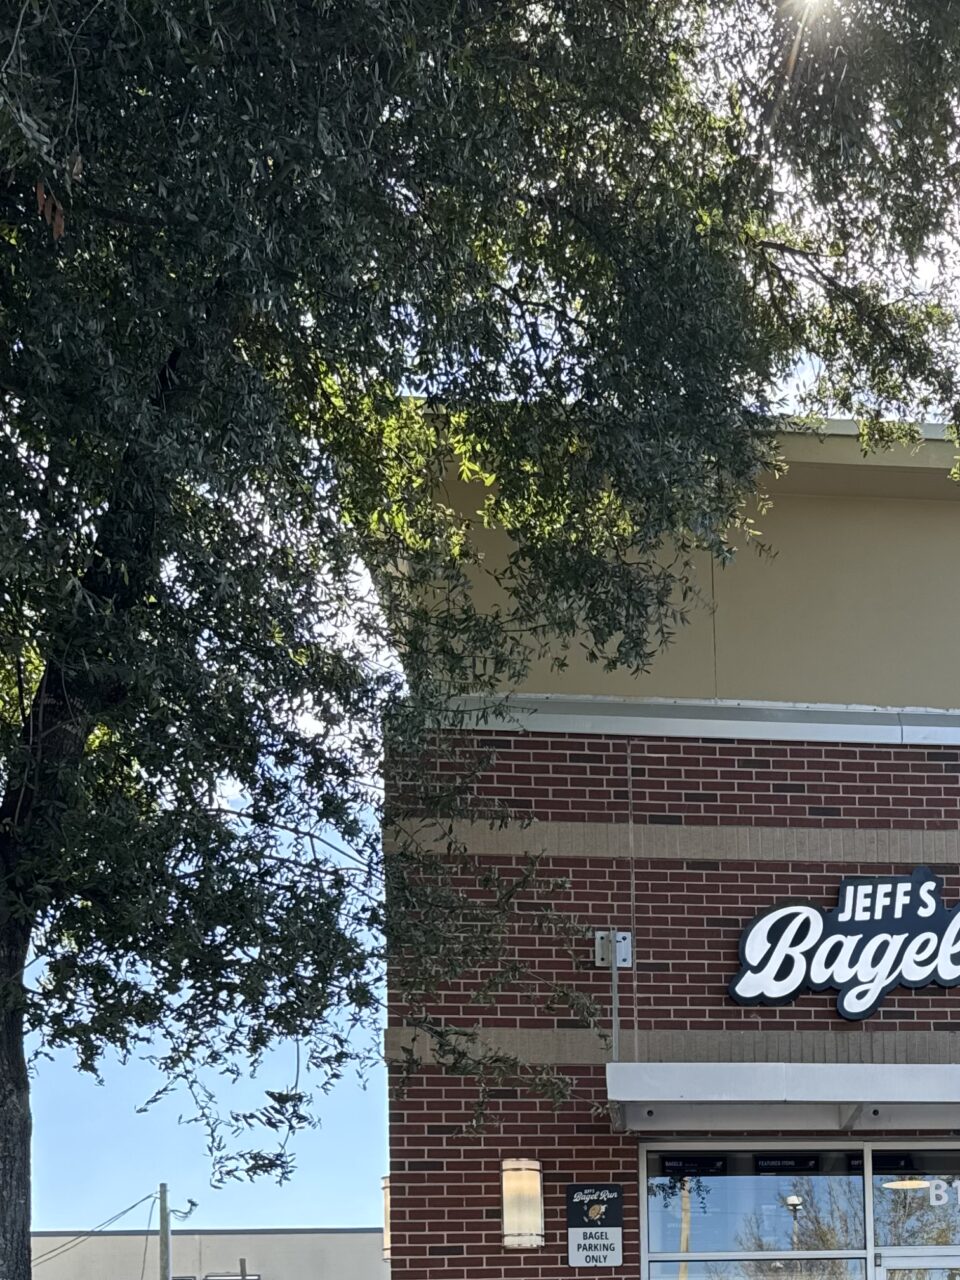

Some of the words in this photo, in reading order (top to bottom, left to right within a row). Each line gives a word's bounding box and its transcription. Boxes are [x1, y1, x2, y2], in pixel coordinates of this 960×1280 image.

[573, 1191, 600, 1203] Bagel
[599, 1190, 618, 1201] Run
[582, 1231, 610, 1241] BAGEL
[577, 1243, 616, 1252] PARKING
[584, 1254, 608, 1264] ONLY
